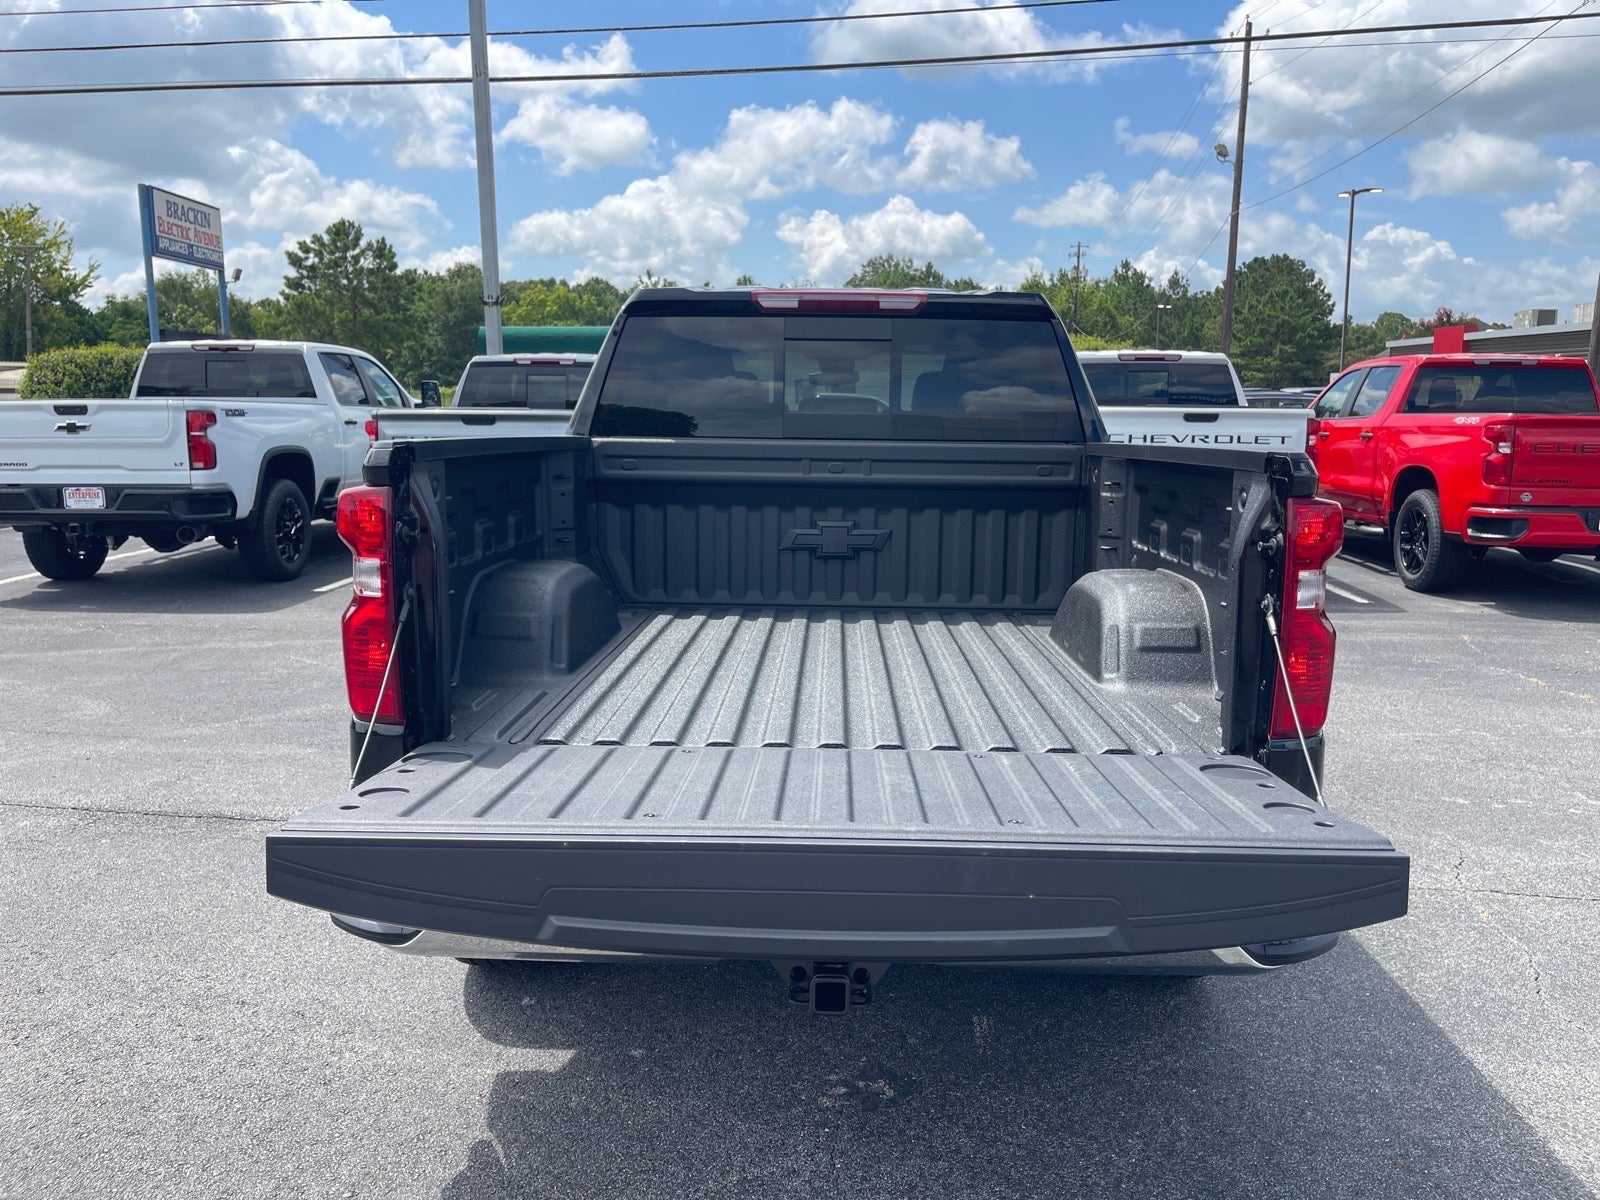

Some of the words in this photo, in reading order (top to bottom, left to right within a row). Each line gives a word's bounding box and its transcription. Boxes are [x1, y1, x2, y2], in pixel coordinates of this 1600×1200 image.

[165, 199, 211, 230] BRACKIN
[157, 215, 192, 242] ELECTRIC
[193, 226, 222, 249] AVENUE
[158, 236, 189, 255] APPLIANCES
[1108, 433, 1292, 445] CHEVROLET
[68, 491, 101, 500] ENTERPRISE
